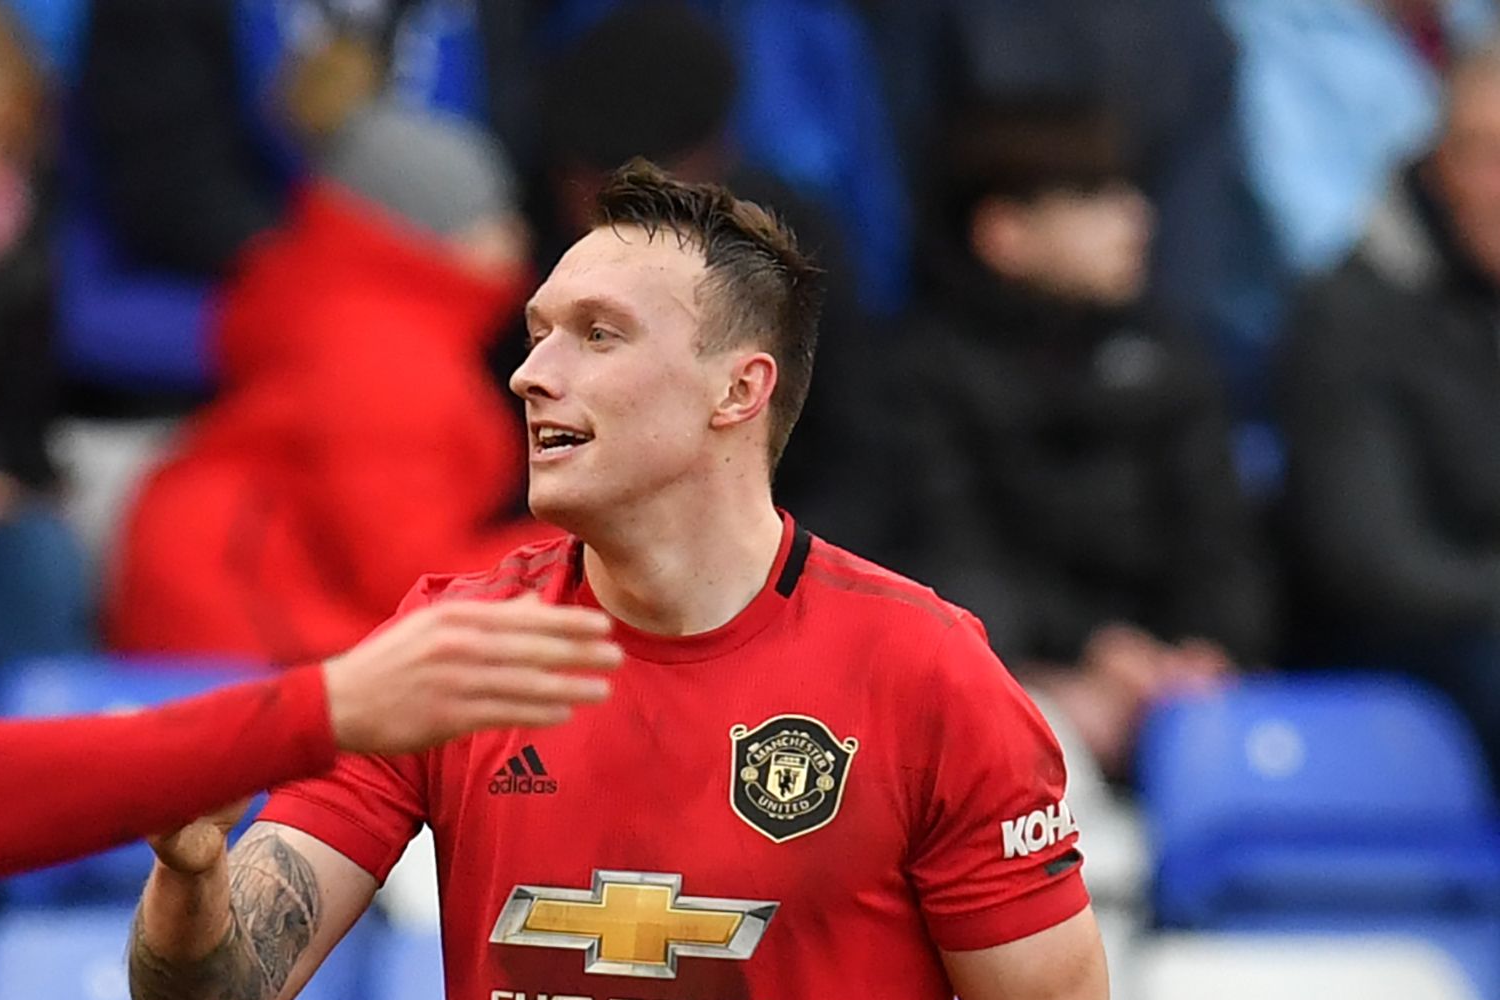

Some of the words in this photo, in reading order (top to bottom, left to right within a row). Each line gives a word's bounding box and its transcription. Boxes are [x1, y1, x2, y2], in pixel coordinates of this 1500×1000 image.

[753, 735, 828, 770] MANCHESTER
[488, 774, 558, 796] adidas
[757, 794, 810, 814] UNITED
[1001, 800, 1079, 859] KOHL
